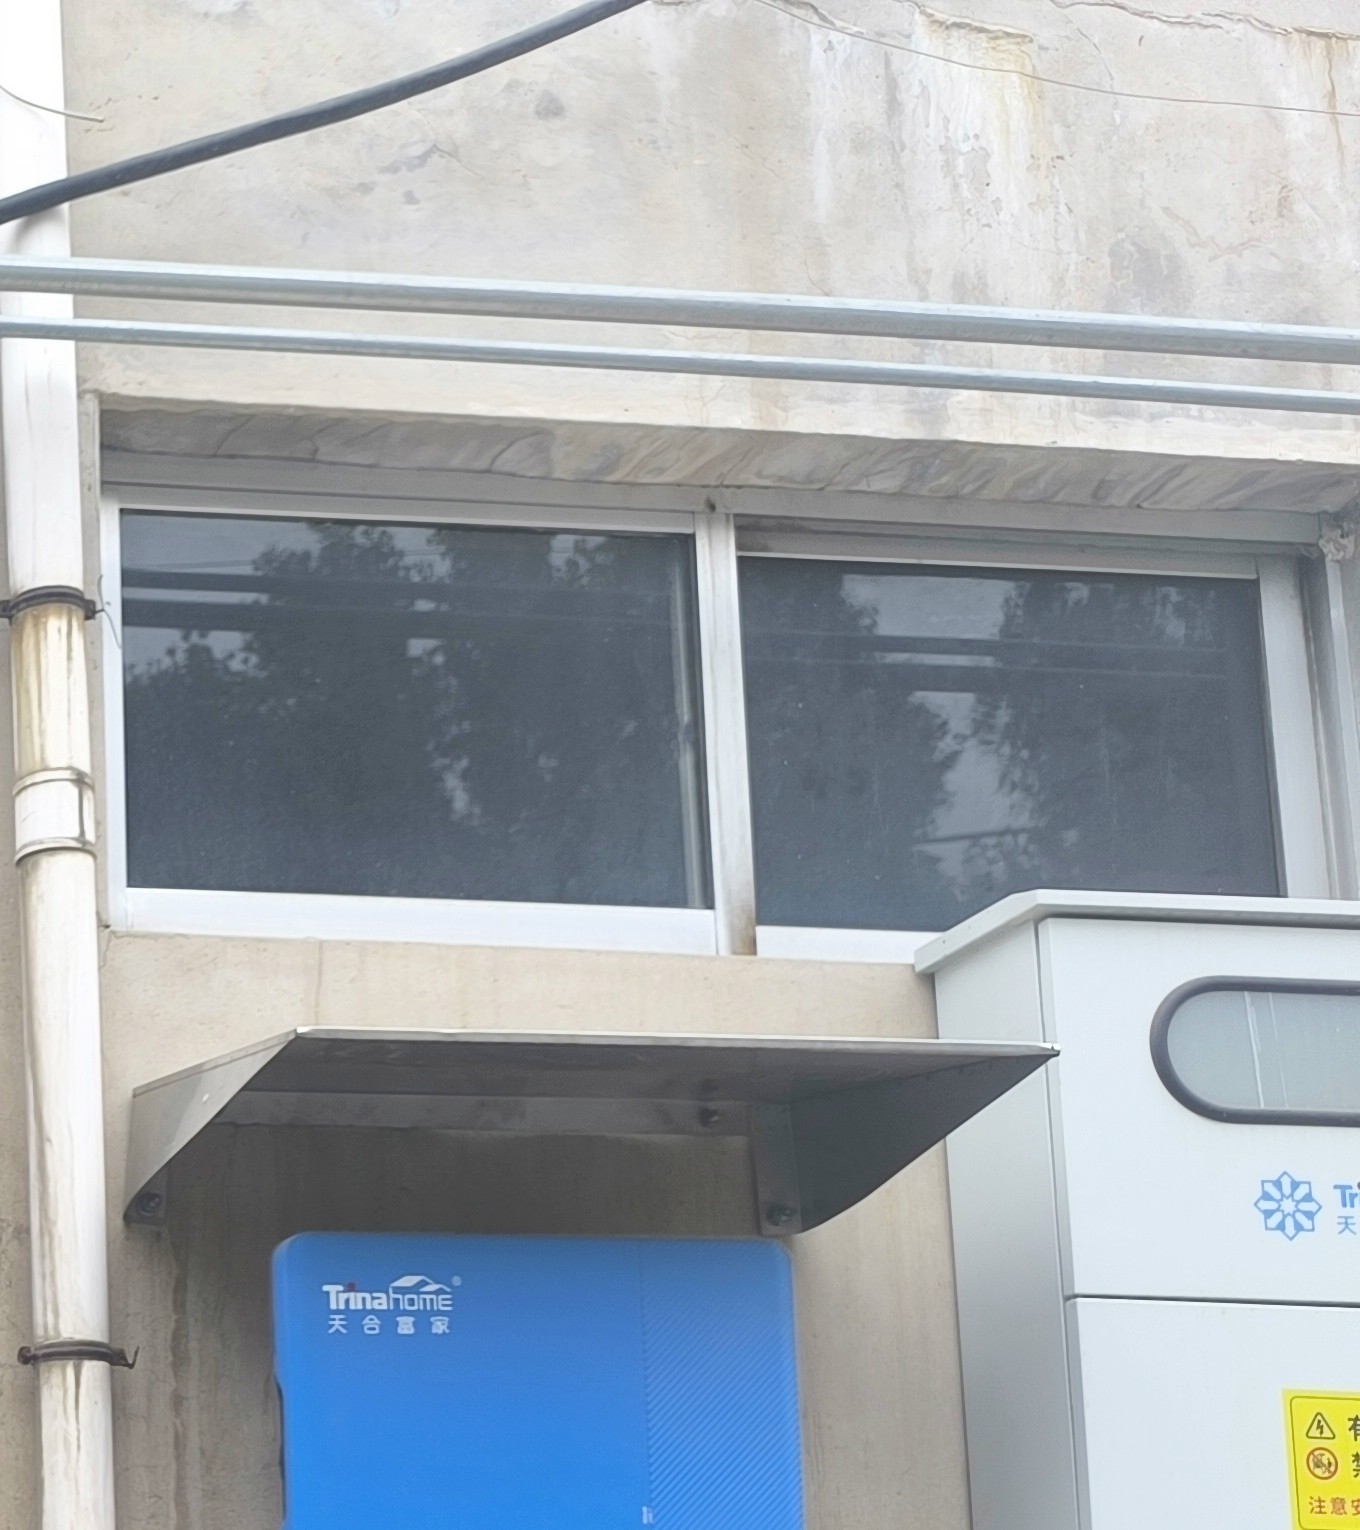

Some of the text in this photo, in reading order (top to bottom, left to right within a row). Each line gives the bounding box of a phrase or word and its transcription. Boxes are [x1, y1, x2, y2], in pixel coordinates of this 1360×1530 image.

[1333, 1183, 1360, 1208] Tr
[1337, 1215, 1357, 1236] 天
[328, 1314, 451, 1335] 天合富家
